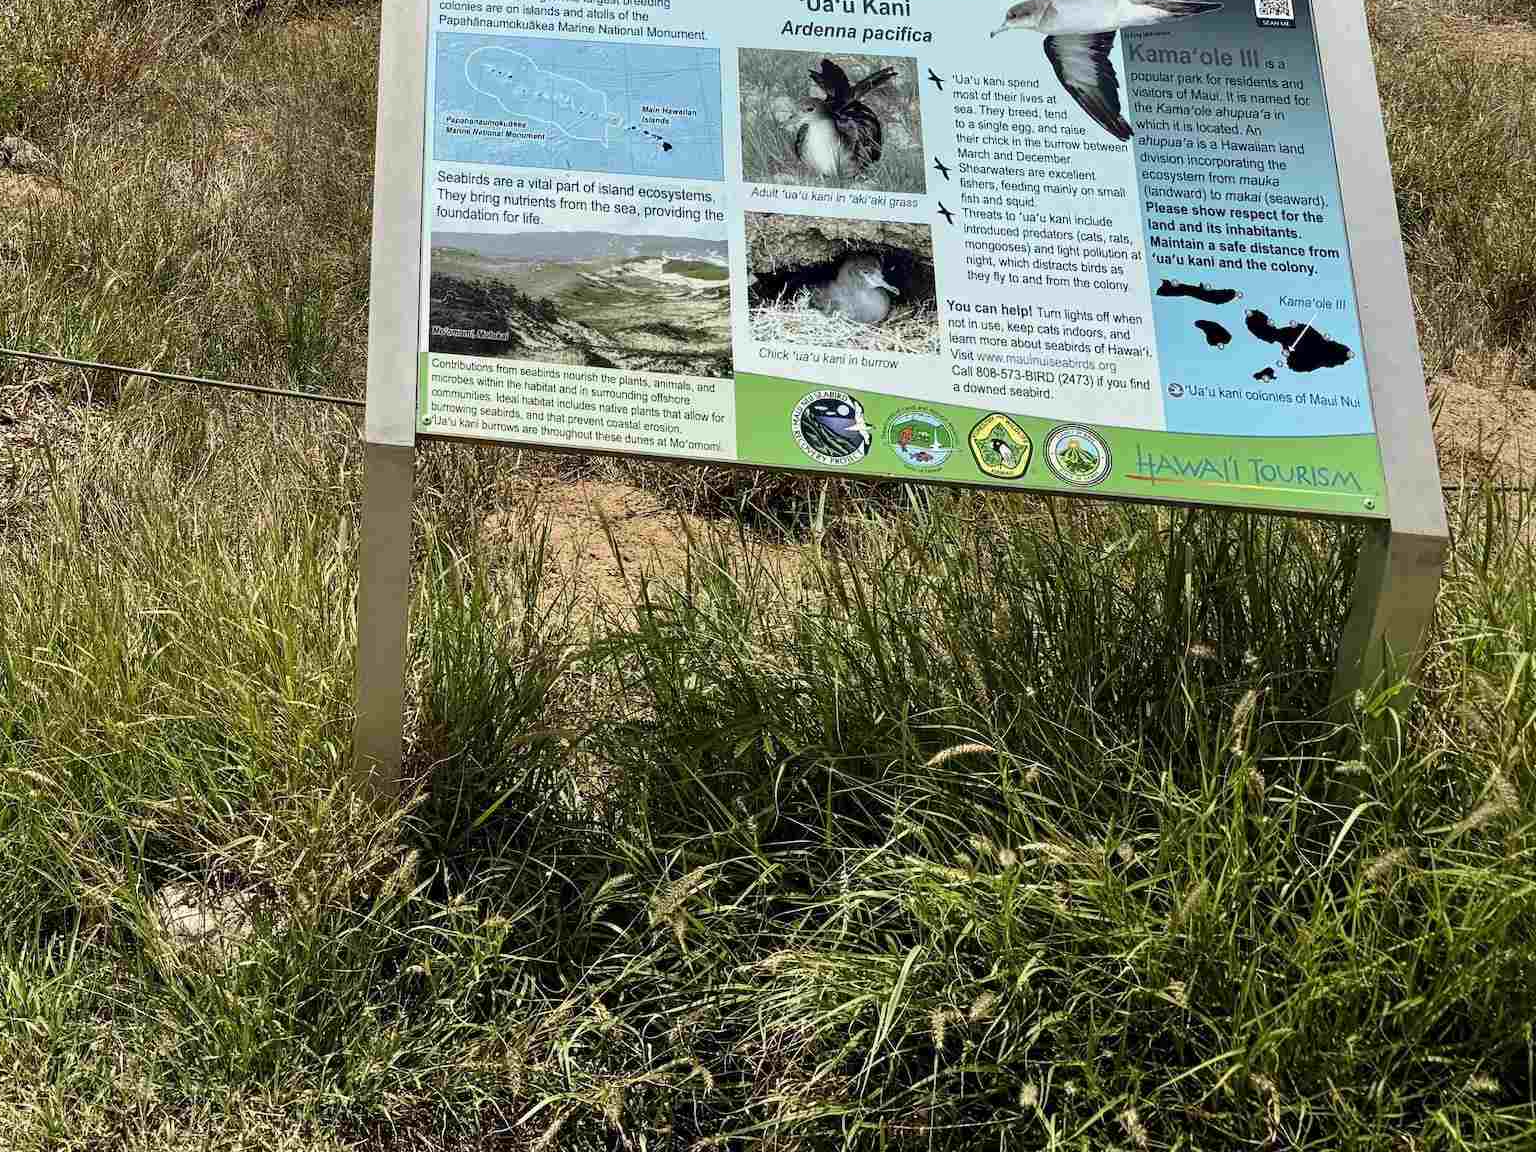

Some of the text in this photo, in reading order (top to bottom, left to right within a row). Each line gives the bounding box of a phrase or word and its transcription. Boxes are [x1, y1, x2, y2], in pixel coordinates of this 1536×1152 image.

[439, 0, 648, 21] colonies are on islands and atolls of the
[557, 21, 594, 33] Marine
[598, 24, 643, 36] National
[646, 26, 707, 40] Monument.
[780, 20, 933, 46] Ardenna pacifica
[1238, 48, 1260, 68] III
[1263, 59, 1274, 68] is
[954, 119, 965, 128] to
[977, 120, 1009, 132] single
[1010, 124, 1033, 134] egg,
[1036, 124, 1057, 133] and
[1059, 125, 1086, 135] raise
[958, 162, 1096, 180] Shearwaters are excellent
[1141, 168, 1280, 187] ecosystem from mauka
[437, 172, 714, 204] Seabirds are a vital part of island ecosystems.
[1143, 185, 1328, 208] (landward) to makai (seaward).
[436, 188, 724, 222] They bring nutrients from the sea, providing the
[436, 206, 542, 224] foundation for life.
[1145, 201, 1324, 223] Please show respect for the
[962, 207, 1002, 220] Threats
[1004, 210, 1016, 220] to
[1048, 213, 1071, 224] kani
[1073, 215, 1113, 227] include
[1147, 219, 1302, 239] land and its inhabitants.
[1149, 236, 1340, 258] Maintain a safe distance from
[966, 254, 1124, 274] night, which distracts birds as
[1187, 255, 1215, 267] kani
[1218, 257, 1243, 269] and
[1245, 259, 1267, 271] the
[1269, 261, 1318, 277] colony.
[946, 300, 1143, 324] You can help! Turn lights off when
[947, 317, 1131, 340] not in use, keep cats indoors, and
[431, 358, 715, 392] Contributions from seabirds nourish the plants, animals, and
[951, 364, 1151, 391] Call 808-573-BIRD (2473) if you find
[1217, 386, 1243, 399] kani
[1244, 388, 1293, 402] colonies
[1294, 392, 1307, 403] of
[1308, 393, 1338, 406] Maui
[1339, 396, 1361, 407] Nui
